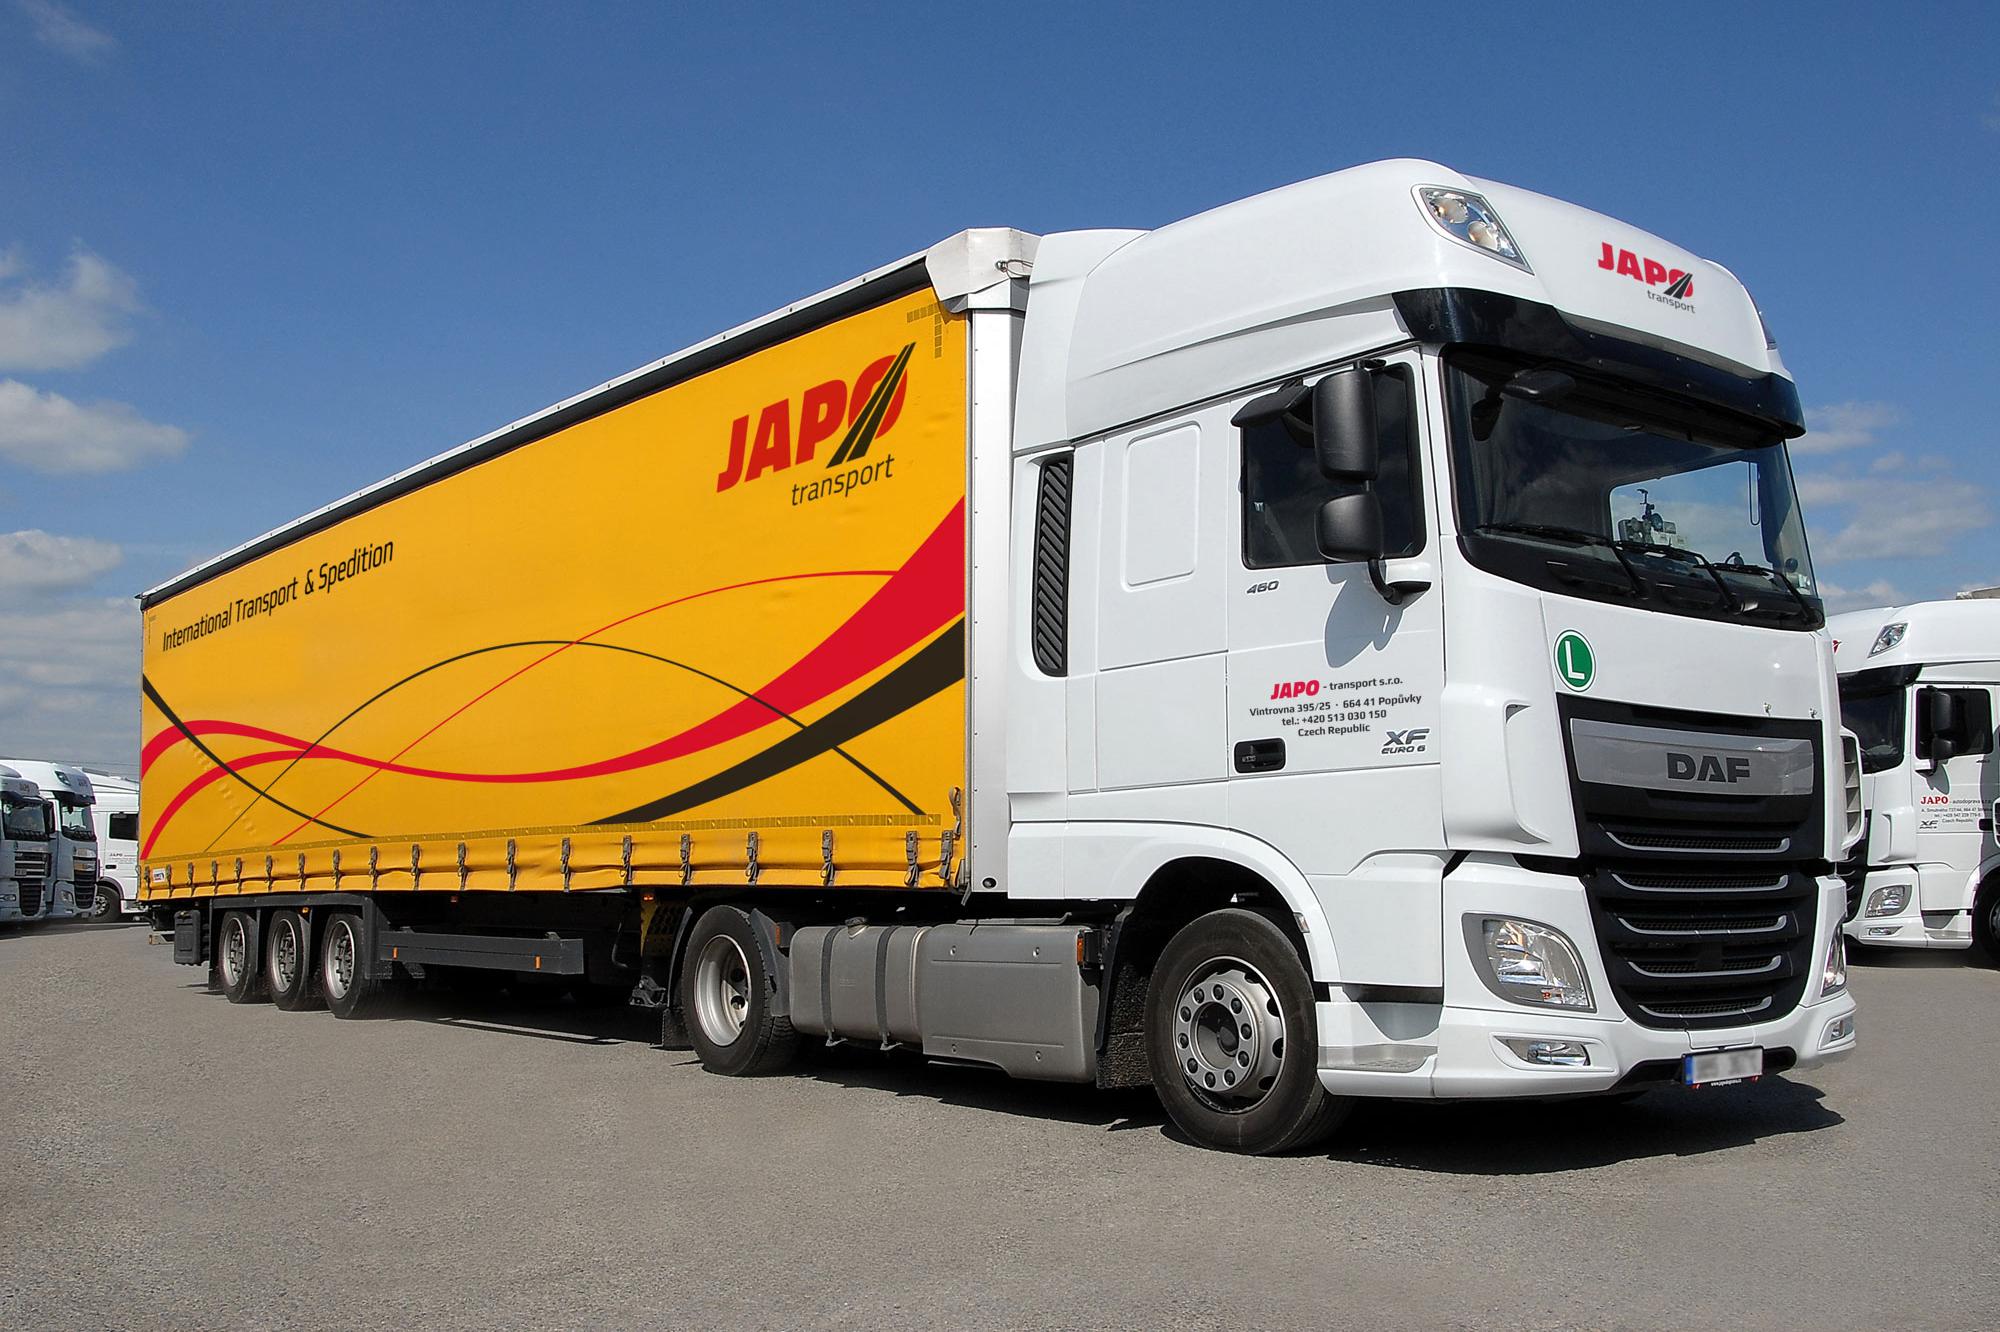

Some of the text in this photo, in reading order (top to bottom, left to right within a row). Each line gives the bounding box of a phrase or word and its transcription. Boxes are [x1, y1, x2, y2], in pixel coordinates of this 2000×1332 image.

[1598, 241, 1693, 299] JAPO
[1647, 289, 1695, 314] transport
[717, 352, 908, 494] JAPO
[791, 453, 896, 506] transport
[162, 540, 394, 652] International Transport & Spedition
[1246, 580, 1280, 594] 460
[1564, 640, 1585, 680] L
[1270, 679, 1320, 700] JAPO
[1329, 678, 1377, 693] transport
[1379, 677, 1403, 686] s.r.o.
[1249, 704, 1295, 717] Vintrovna
[1297, 701, 1331, 713] 395/25
[1342, 698, 1361, 709] 664
[1364, 697, 1375, 708] 41
[1378, 693, 1422, 707] Popůvky
[1282, 709, 1387, 726] tel.: +420 513 030 150
[1298, 724, 1371, 737] Czech Republic
[1383, 728, 1430, 747] XF
[1381, 745, 1426, 755] EURO 6
[1667, 752, 1750, 784] DAF
[1920, 796, 1949, 804] JAPO
